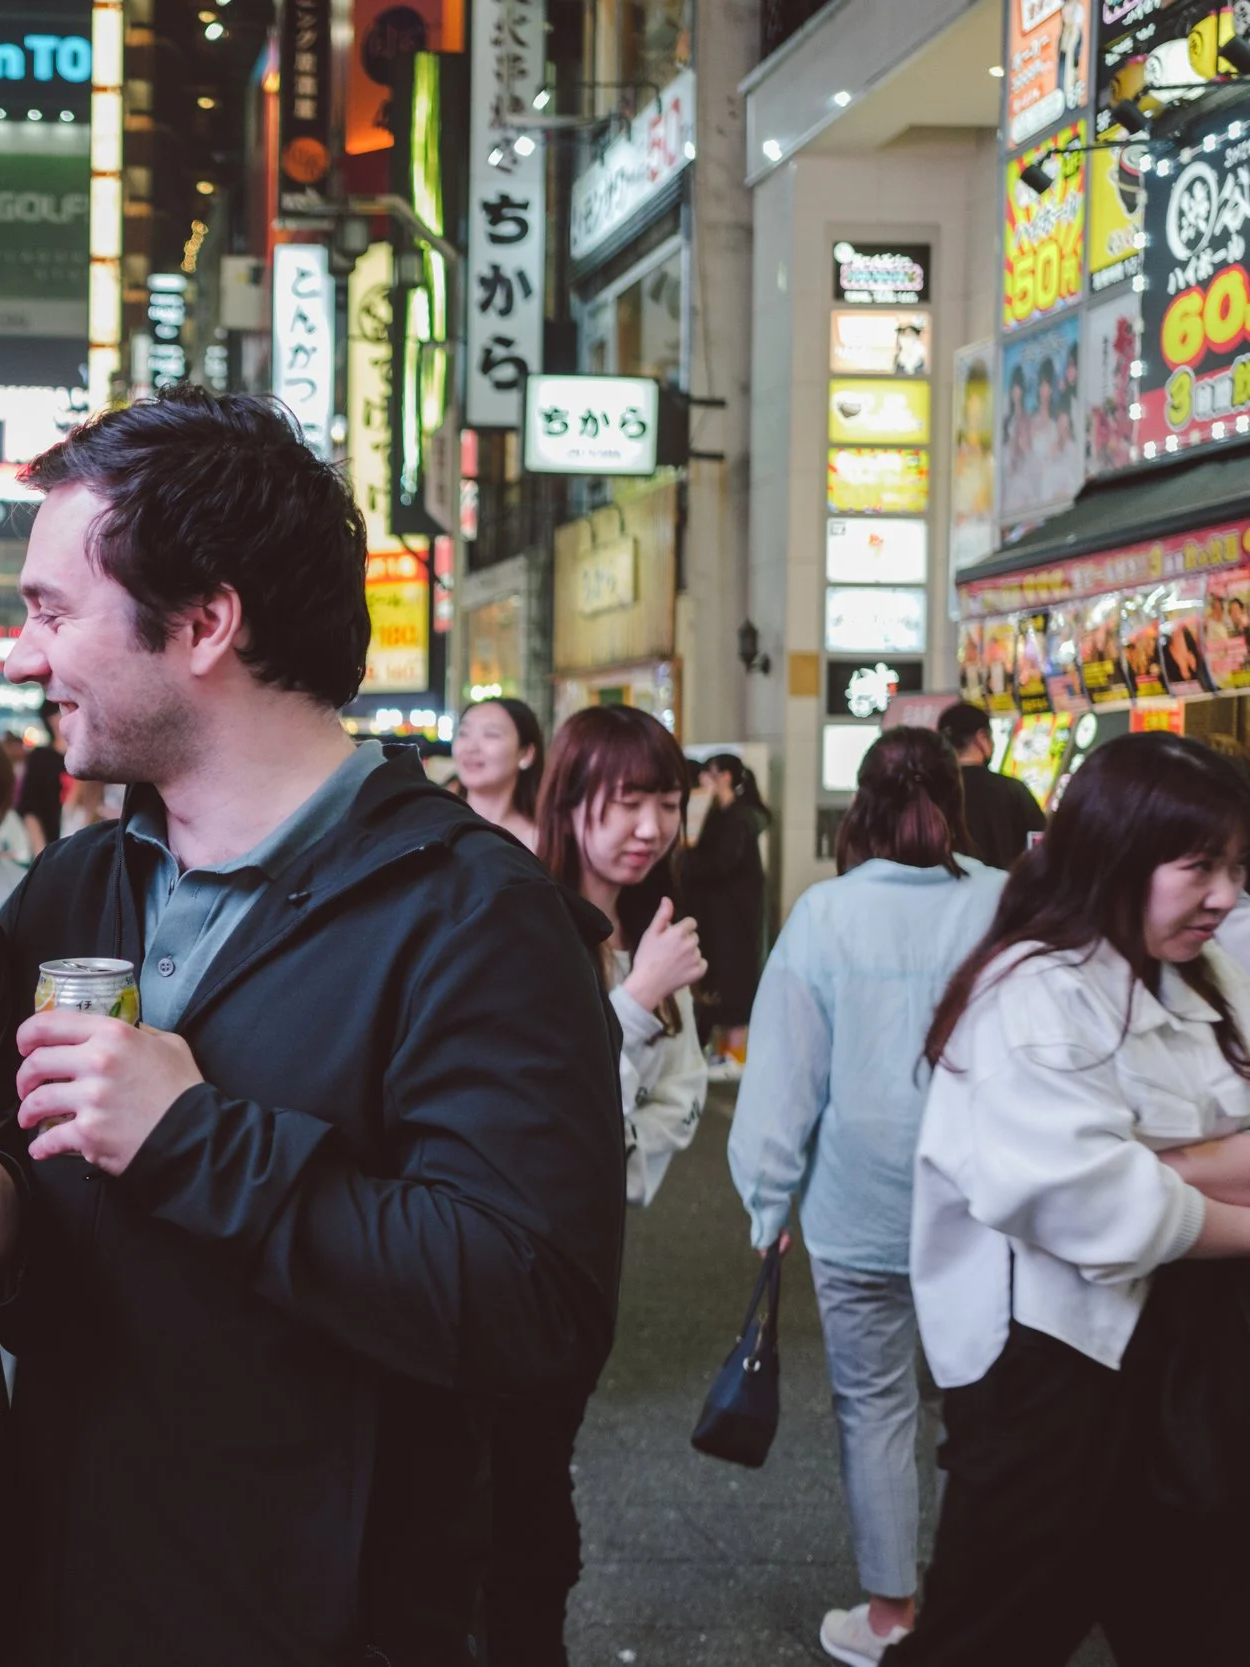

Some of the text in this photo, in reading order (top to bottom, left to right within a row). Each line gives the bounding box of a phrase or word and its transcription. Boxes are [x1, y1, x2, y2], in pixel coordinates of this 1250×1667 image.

[283, 265, 323, 430] とんかつ
[480, 193, 533, 390] ちから
[1160, 265, 1250, 370] 60
[541, 407, 647, 440] ちから
